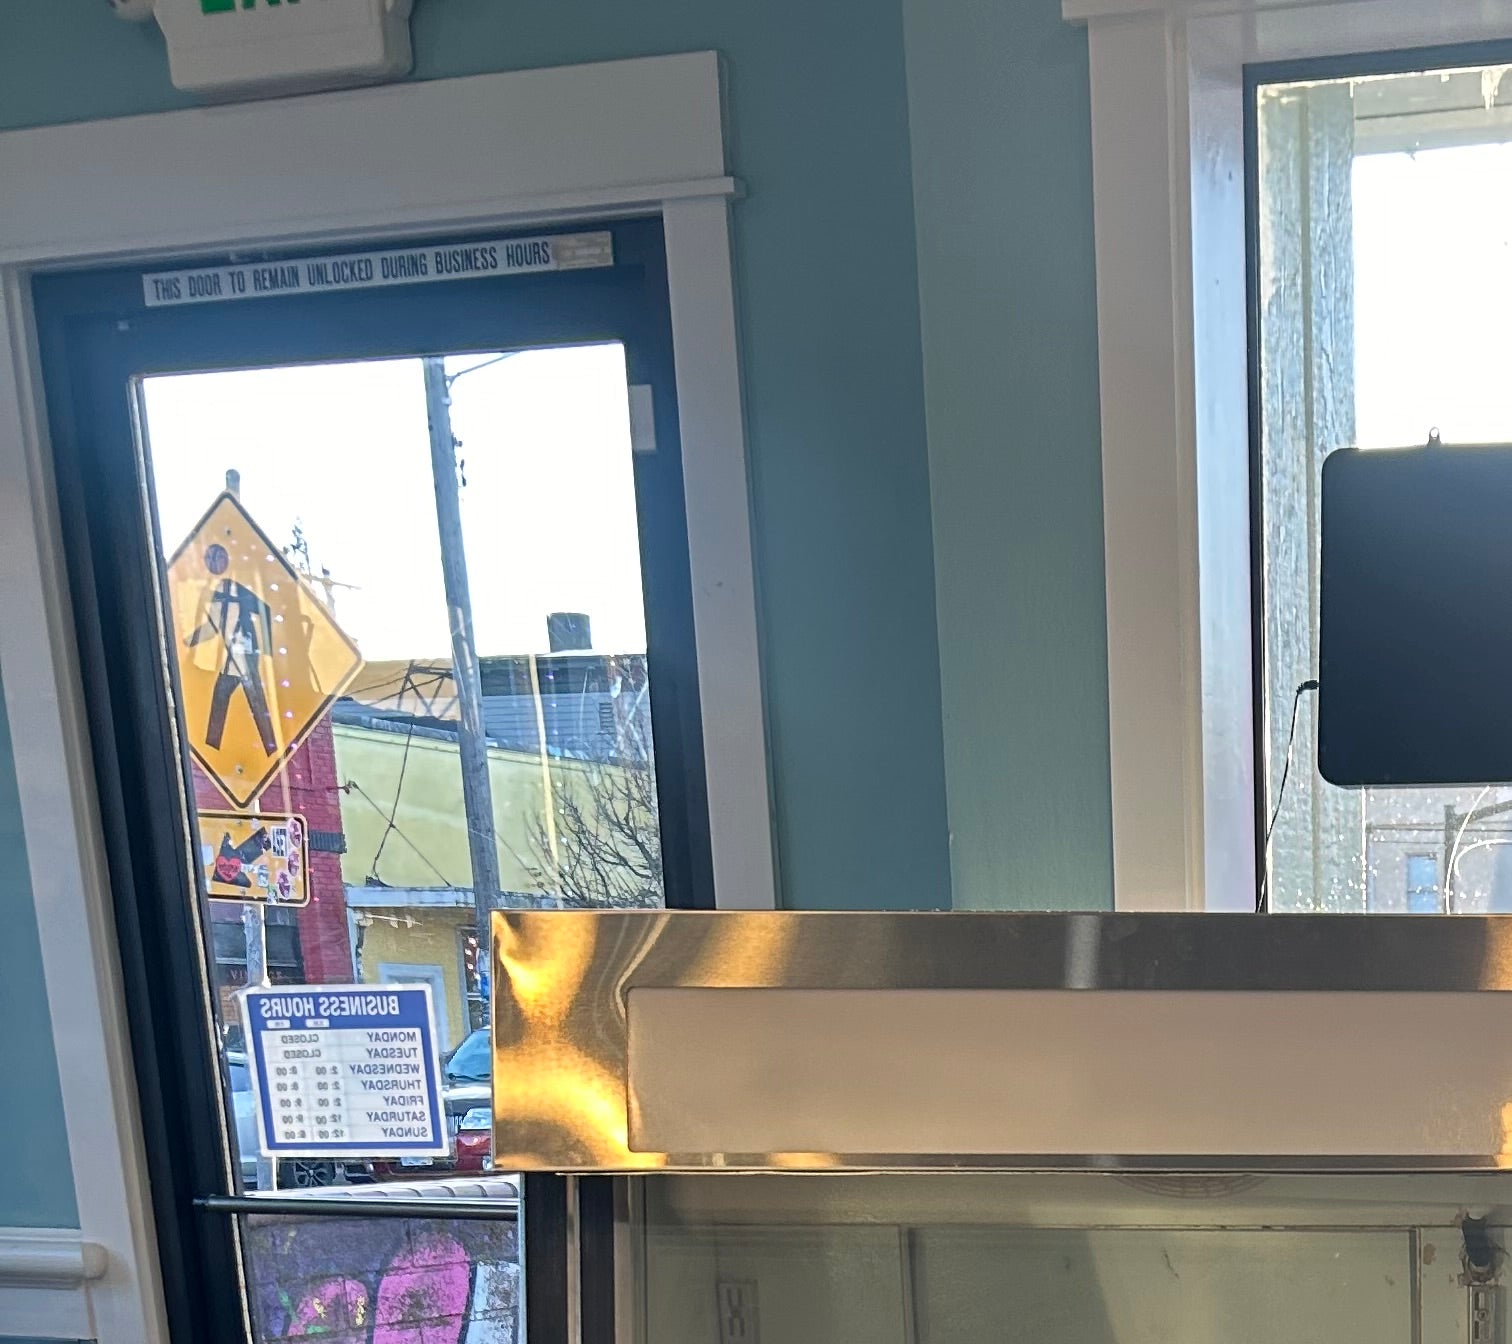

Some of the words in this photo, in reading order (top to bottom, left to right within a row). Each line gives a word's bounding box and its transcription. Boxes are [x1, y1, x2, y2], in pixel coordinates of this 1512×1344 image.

[152, 278, 181, 301] THIS
[189, 274, 223, 298] DOOR
[228, 271, 246, 294] TO
[253, 265, 300, 292] REMAIN
[307, 258, 374, 287] UNLOCKED
[381, 253, 428, 279] DURING
[435, 246, 498, 274] BUSINESS
[506, 241, 550, 267] HOURS
